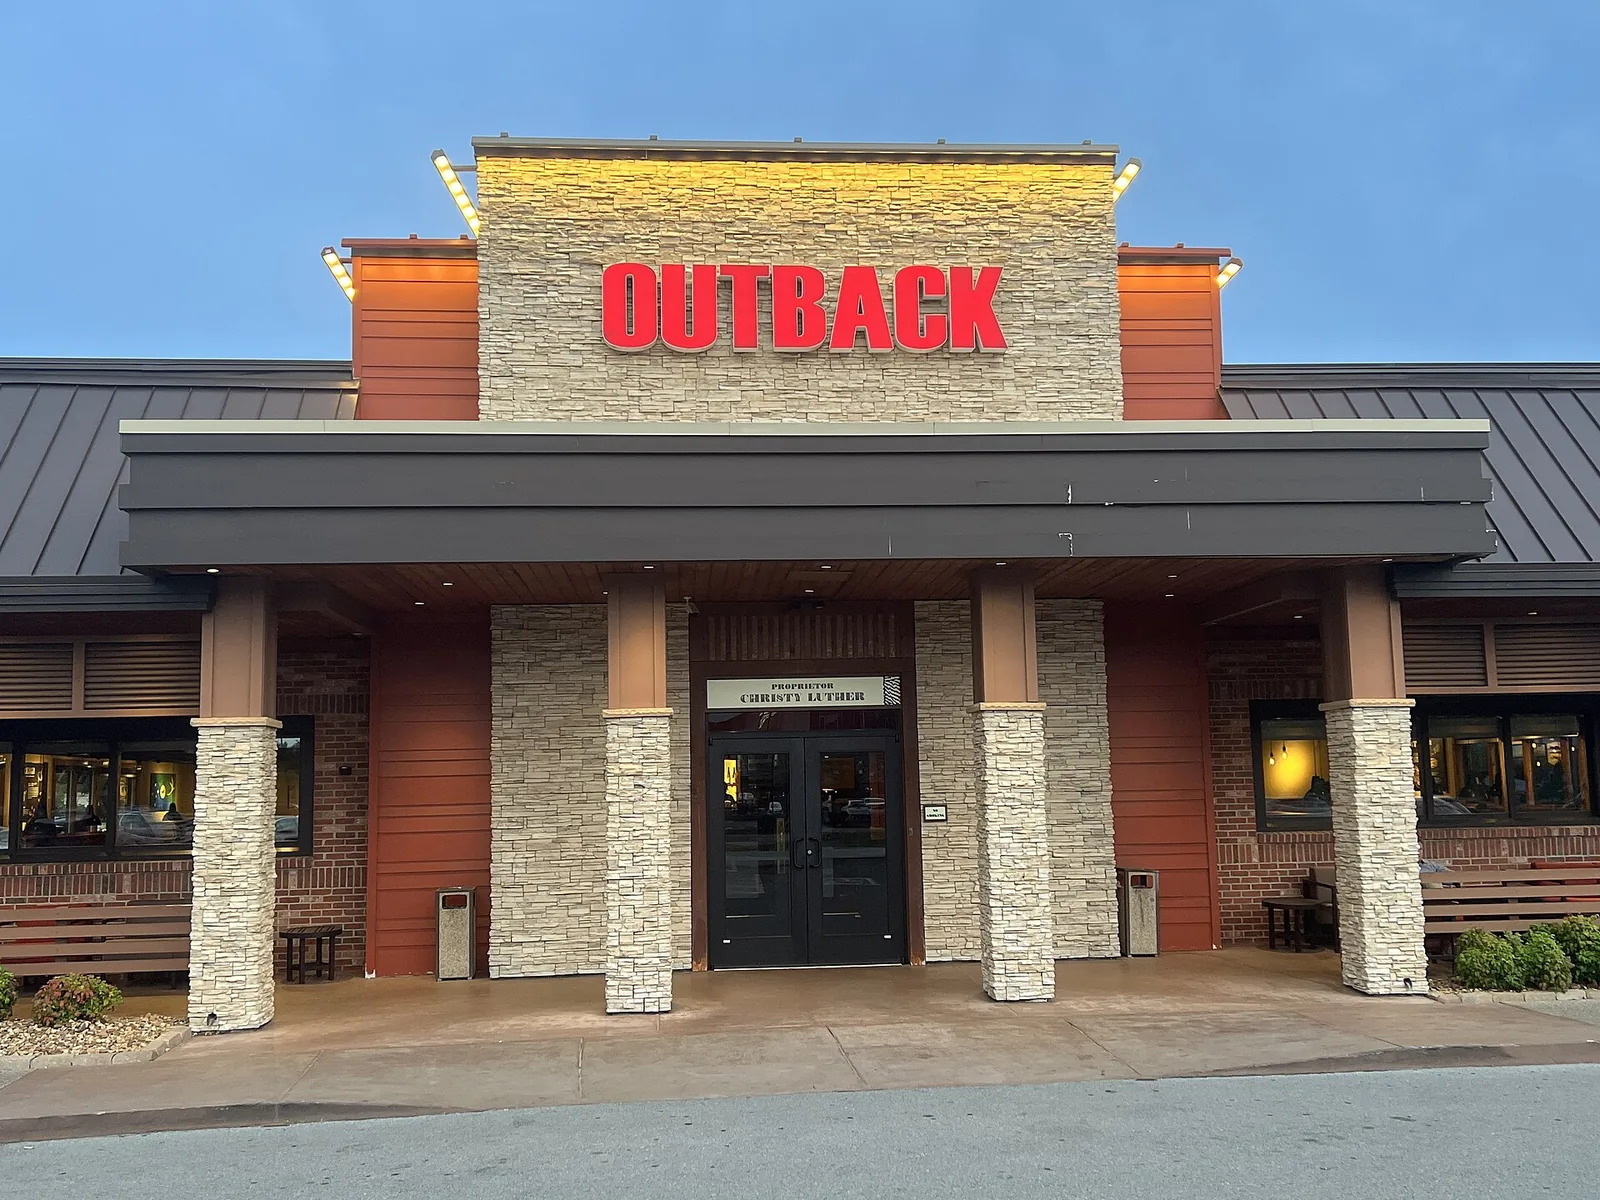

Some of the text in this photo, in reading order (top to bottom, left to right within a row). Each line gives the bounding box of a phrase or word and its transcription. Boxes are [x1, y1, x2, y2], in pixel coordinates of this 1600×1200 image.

[602, 263, 1008, 353] OUTBACK
[740, 692, 865, 703] CHRISTY LUTHER
